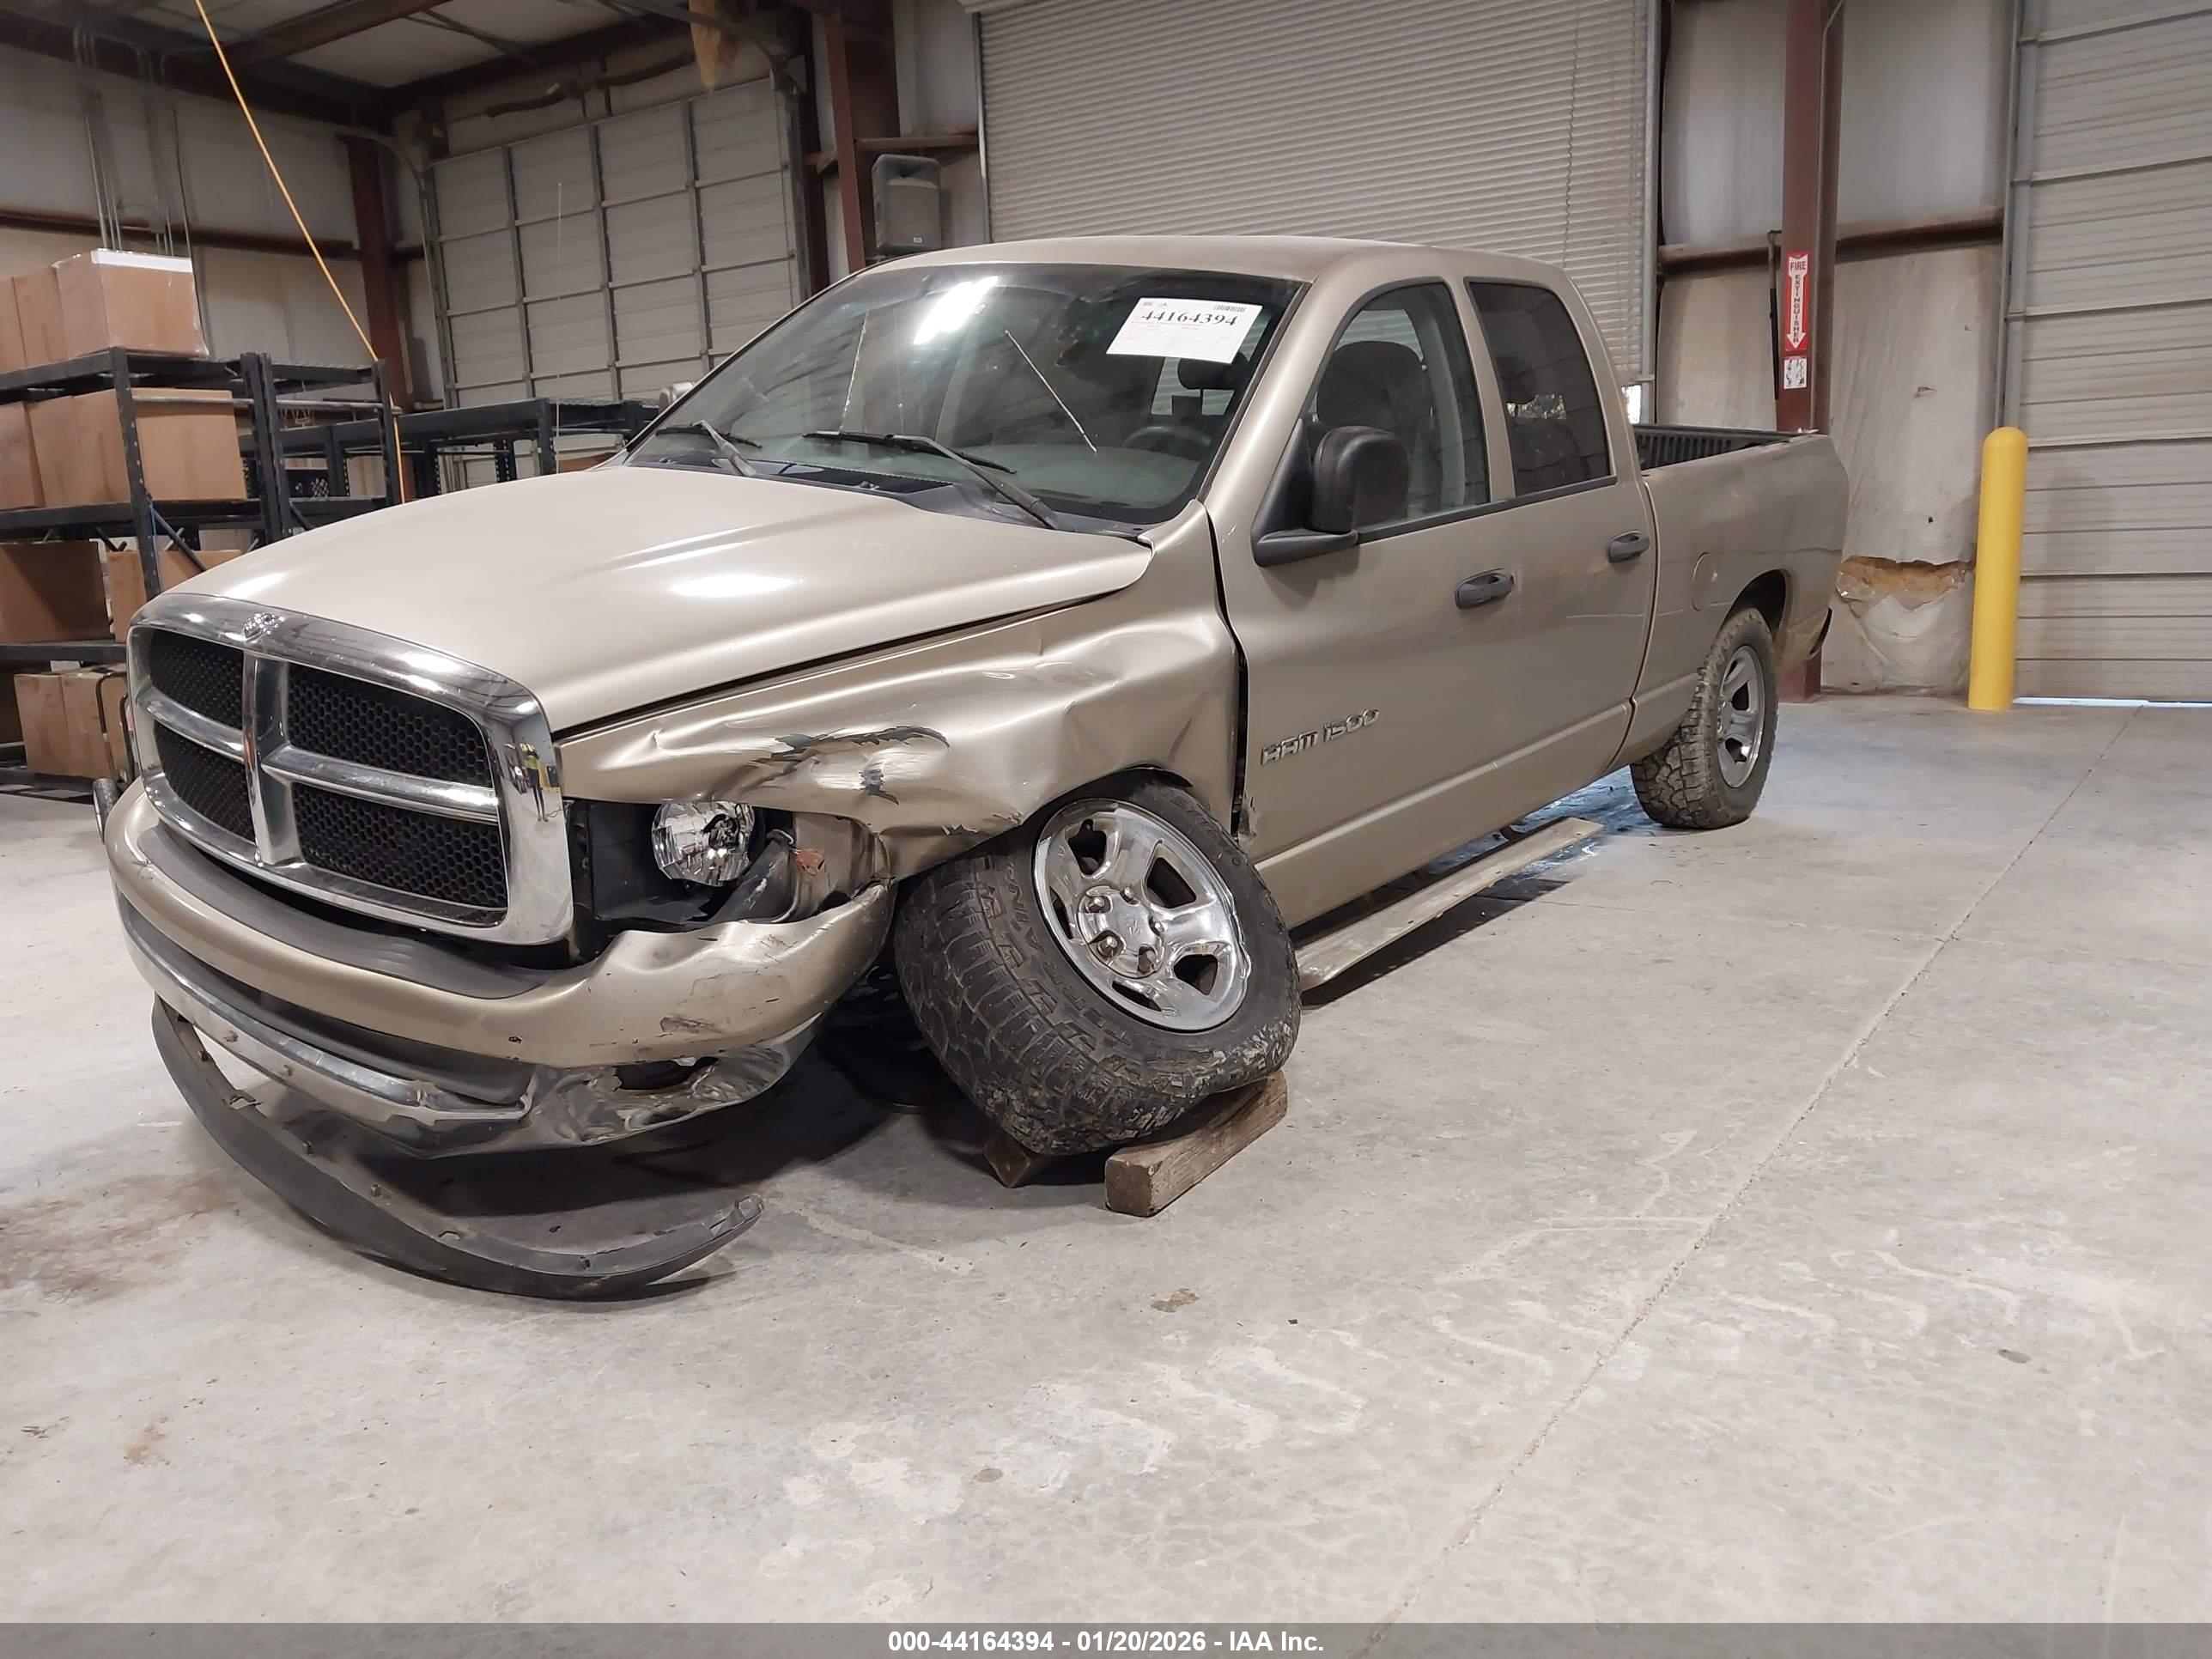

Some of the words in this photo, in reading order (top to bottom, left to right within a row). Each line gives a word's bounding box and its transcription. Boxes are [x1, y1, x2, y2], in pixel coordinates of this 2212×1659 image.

[1790, 261, 1806, 270] FIRE
[1141, 311, 1237, 325] 44164394
[1261, 731, 1318, 765] RAM
[1323, 708, 1379, 742] 1500
